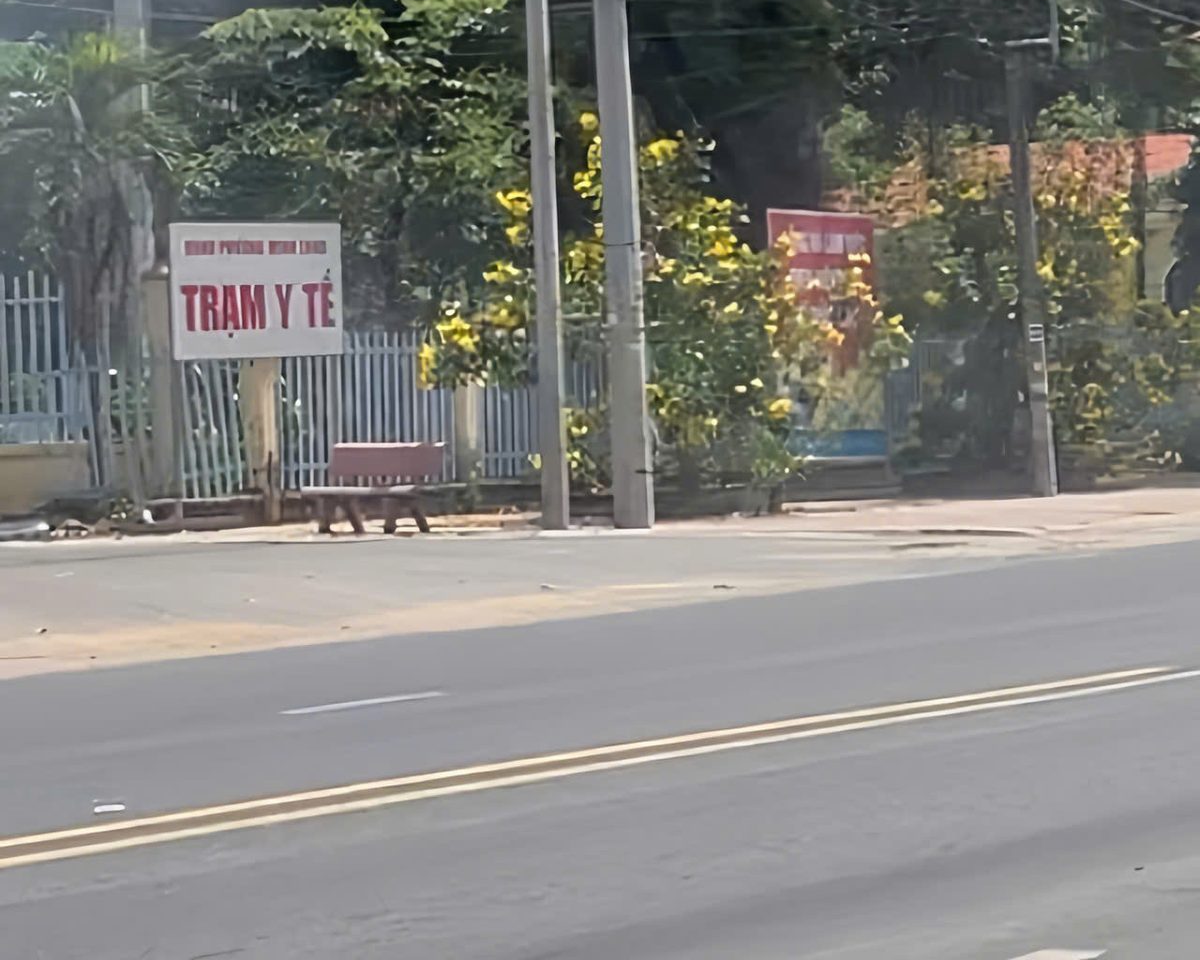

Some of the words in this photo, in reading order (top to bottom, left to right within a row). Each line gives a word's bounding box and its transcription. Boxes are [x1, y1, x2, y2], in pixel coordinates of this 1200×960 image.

[180, 284, 267, 338] TRẠM
[274, 283, 293, 329] Y
[302, 268, 336, 328] TẾ
